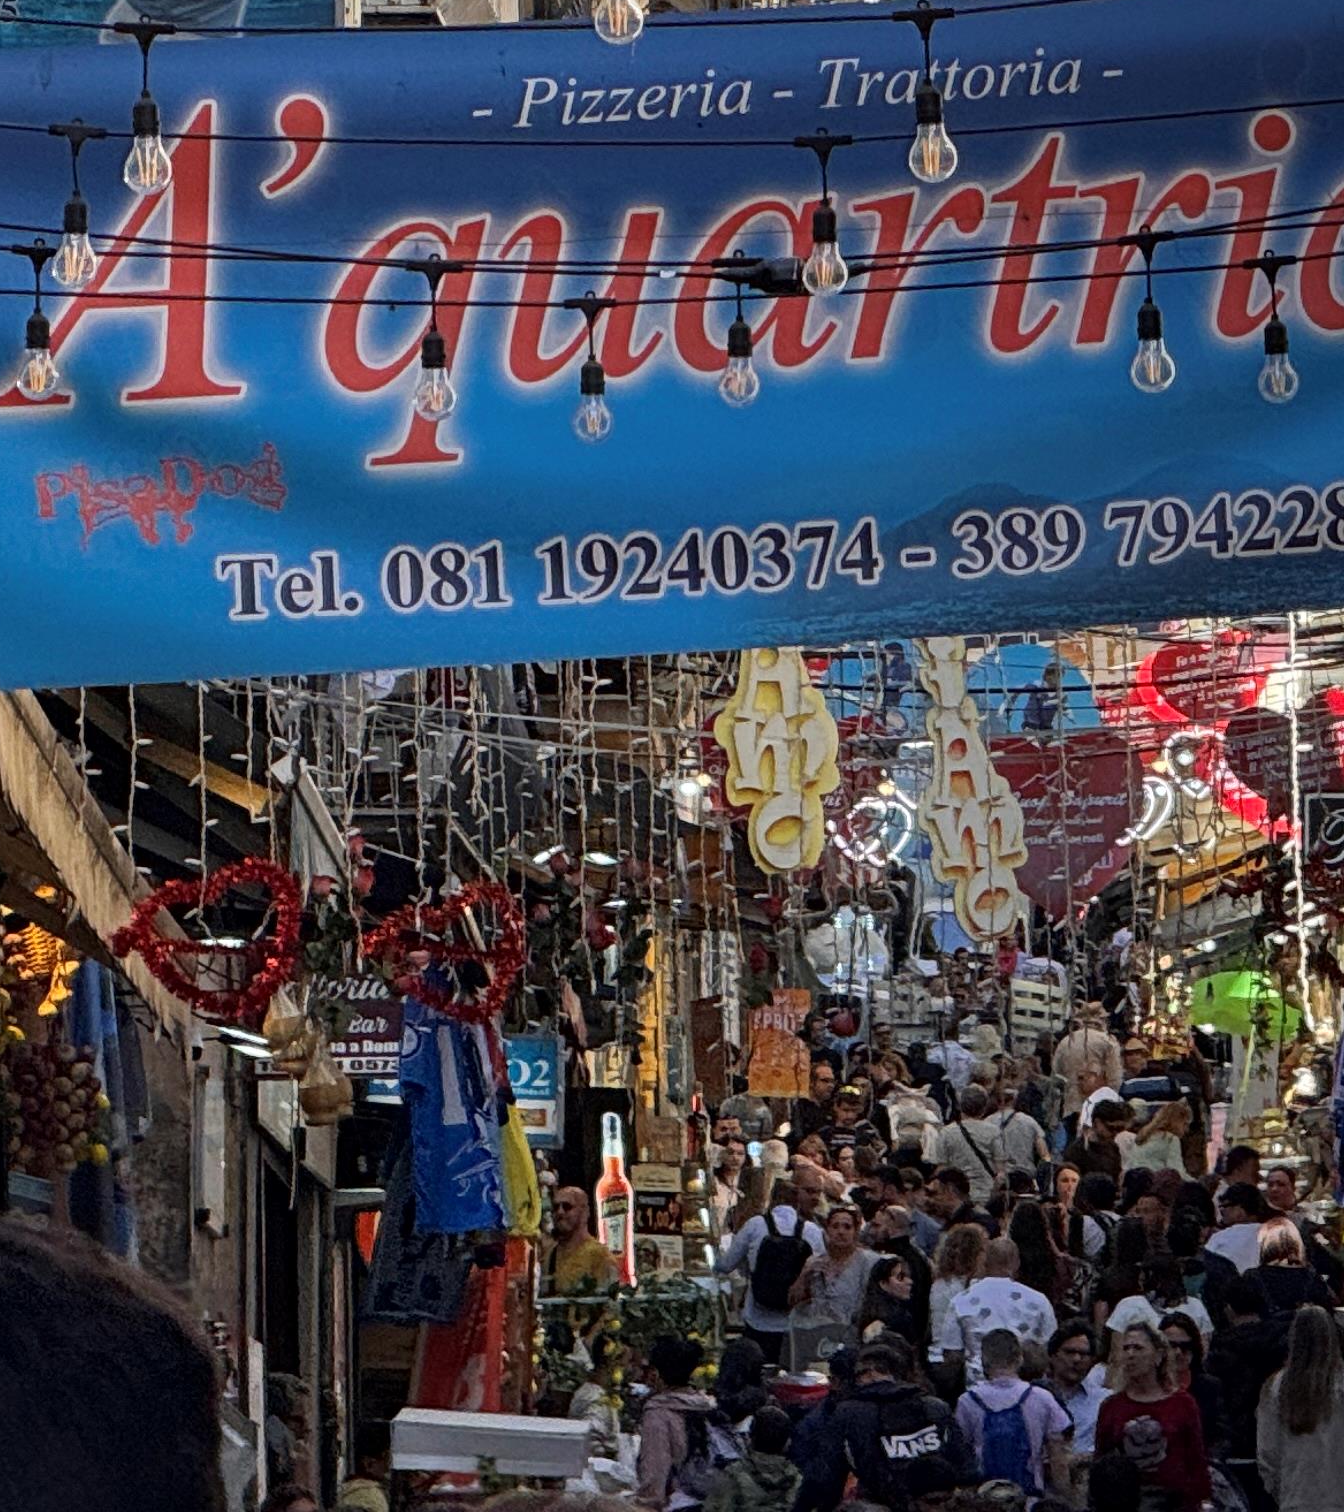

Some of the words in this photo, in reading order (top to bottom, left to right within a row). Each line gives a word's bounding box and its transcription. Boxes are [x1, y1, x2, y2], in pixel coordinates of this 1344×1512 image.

[513, 74, 754, 129] Pizzeria
[817, 46, 1084, 109] Trattoria
[217, 551, 361, 622] Tel.
[383, 541, 513, 614] 081
[536, 516, 883, 609] 19240374
[952, 505, 1085, 579] 389
[347, 1014, 390, 1034] Bar
[879, 1424, 942, 1459] VANS
